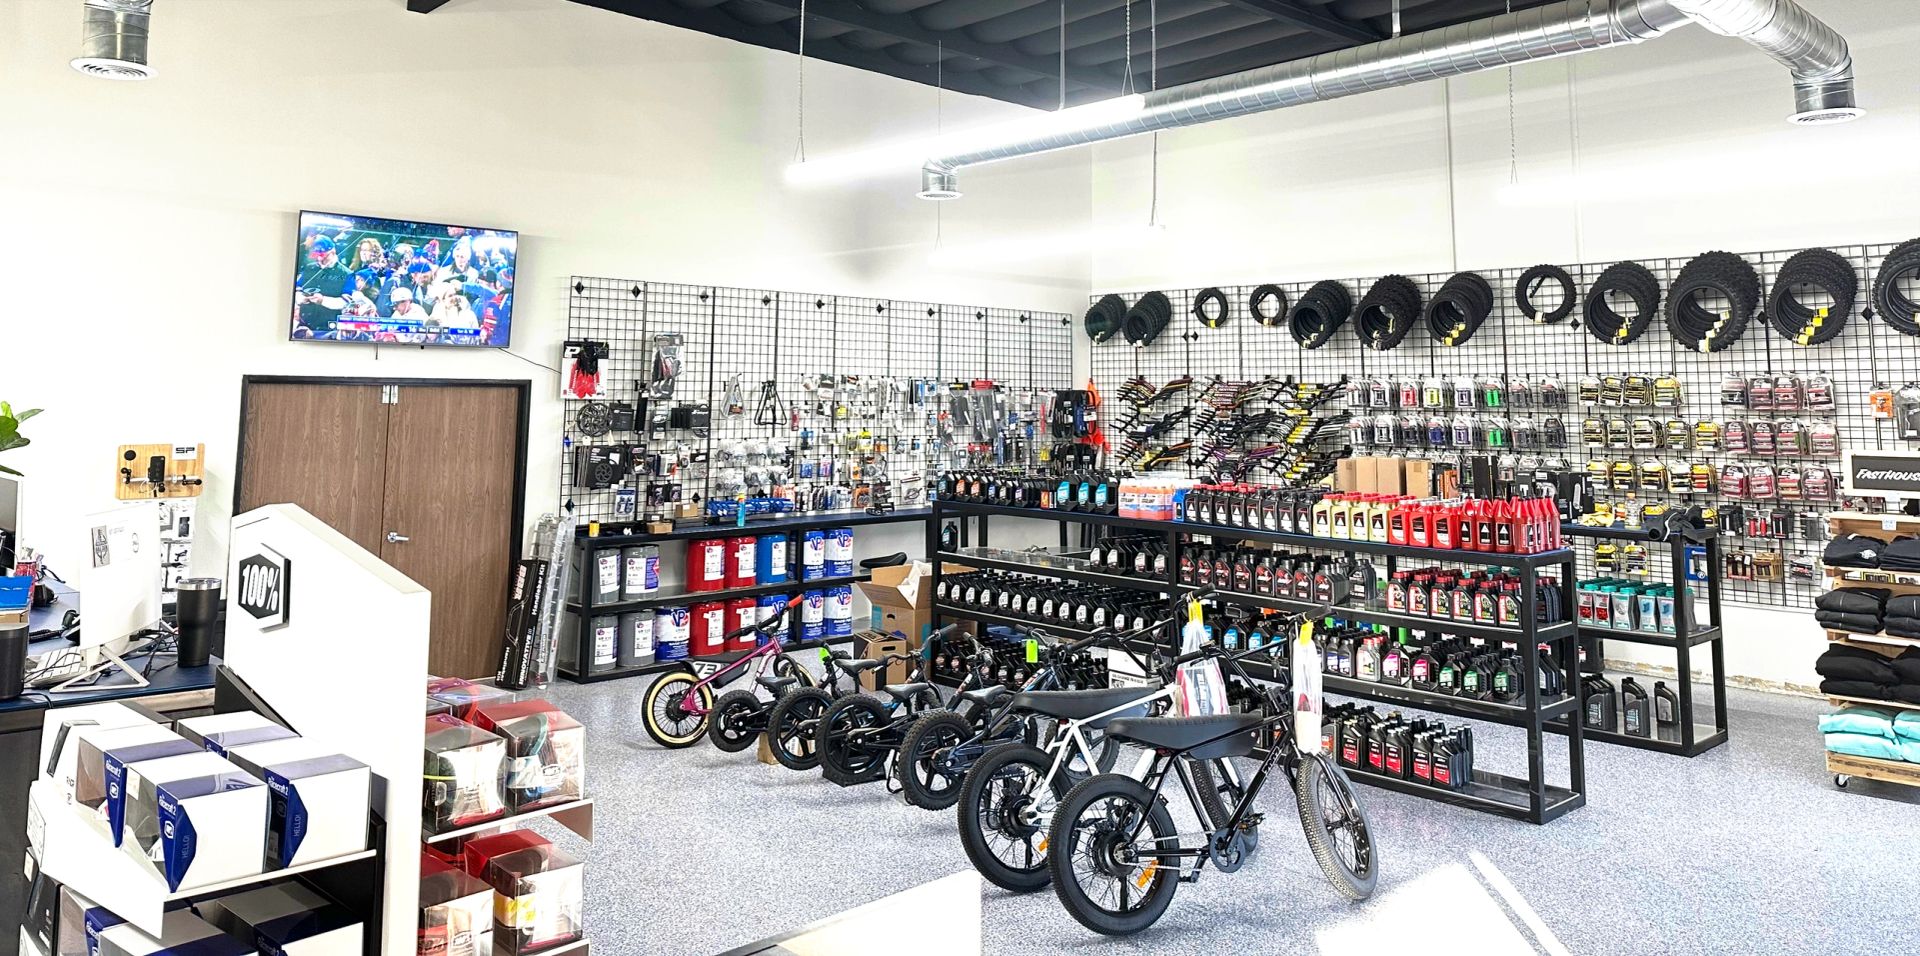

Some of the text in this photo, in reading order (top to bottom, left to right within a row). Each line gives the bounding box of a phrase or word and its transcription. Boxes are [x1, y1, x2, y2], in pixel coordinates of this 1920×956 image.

[1856, 468, 1920, 482] FASTHOUS
[242, 562, 280, 612] 100%
[518, 635, 532, 685] INNOVATIVE
